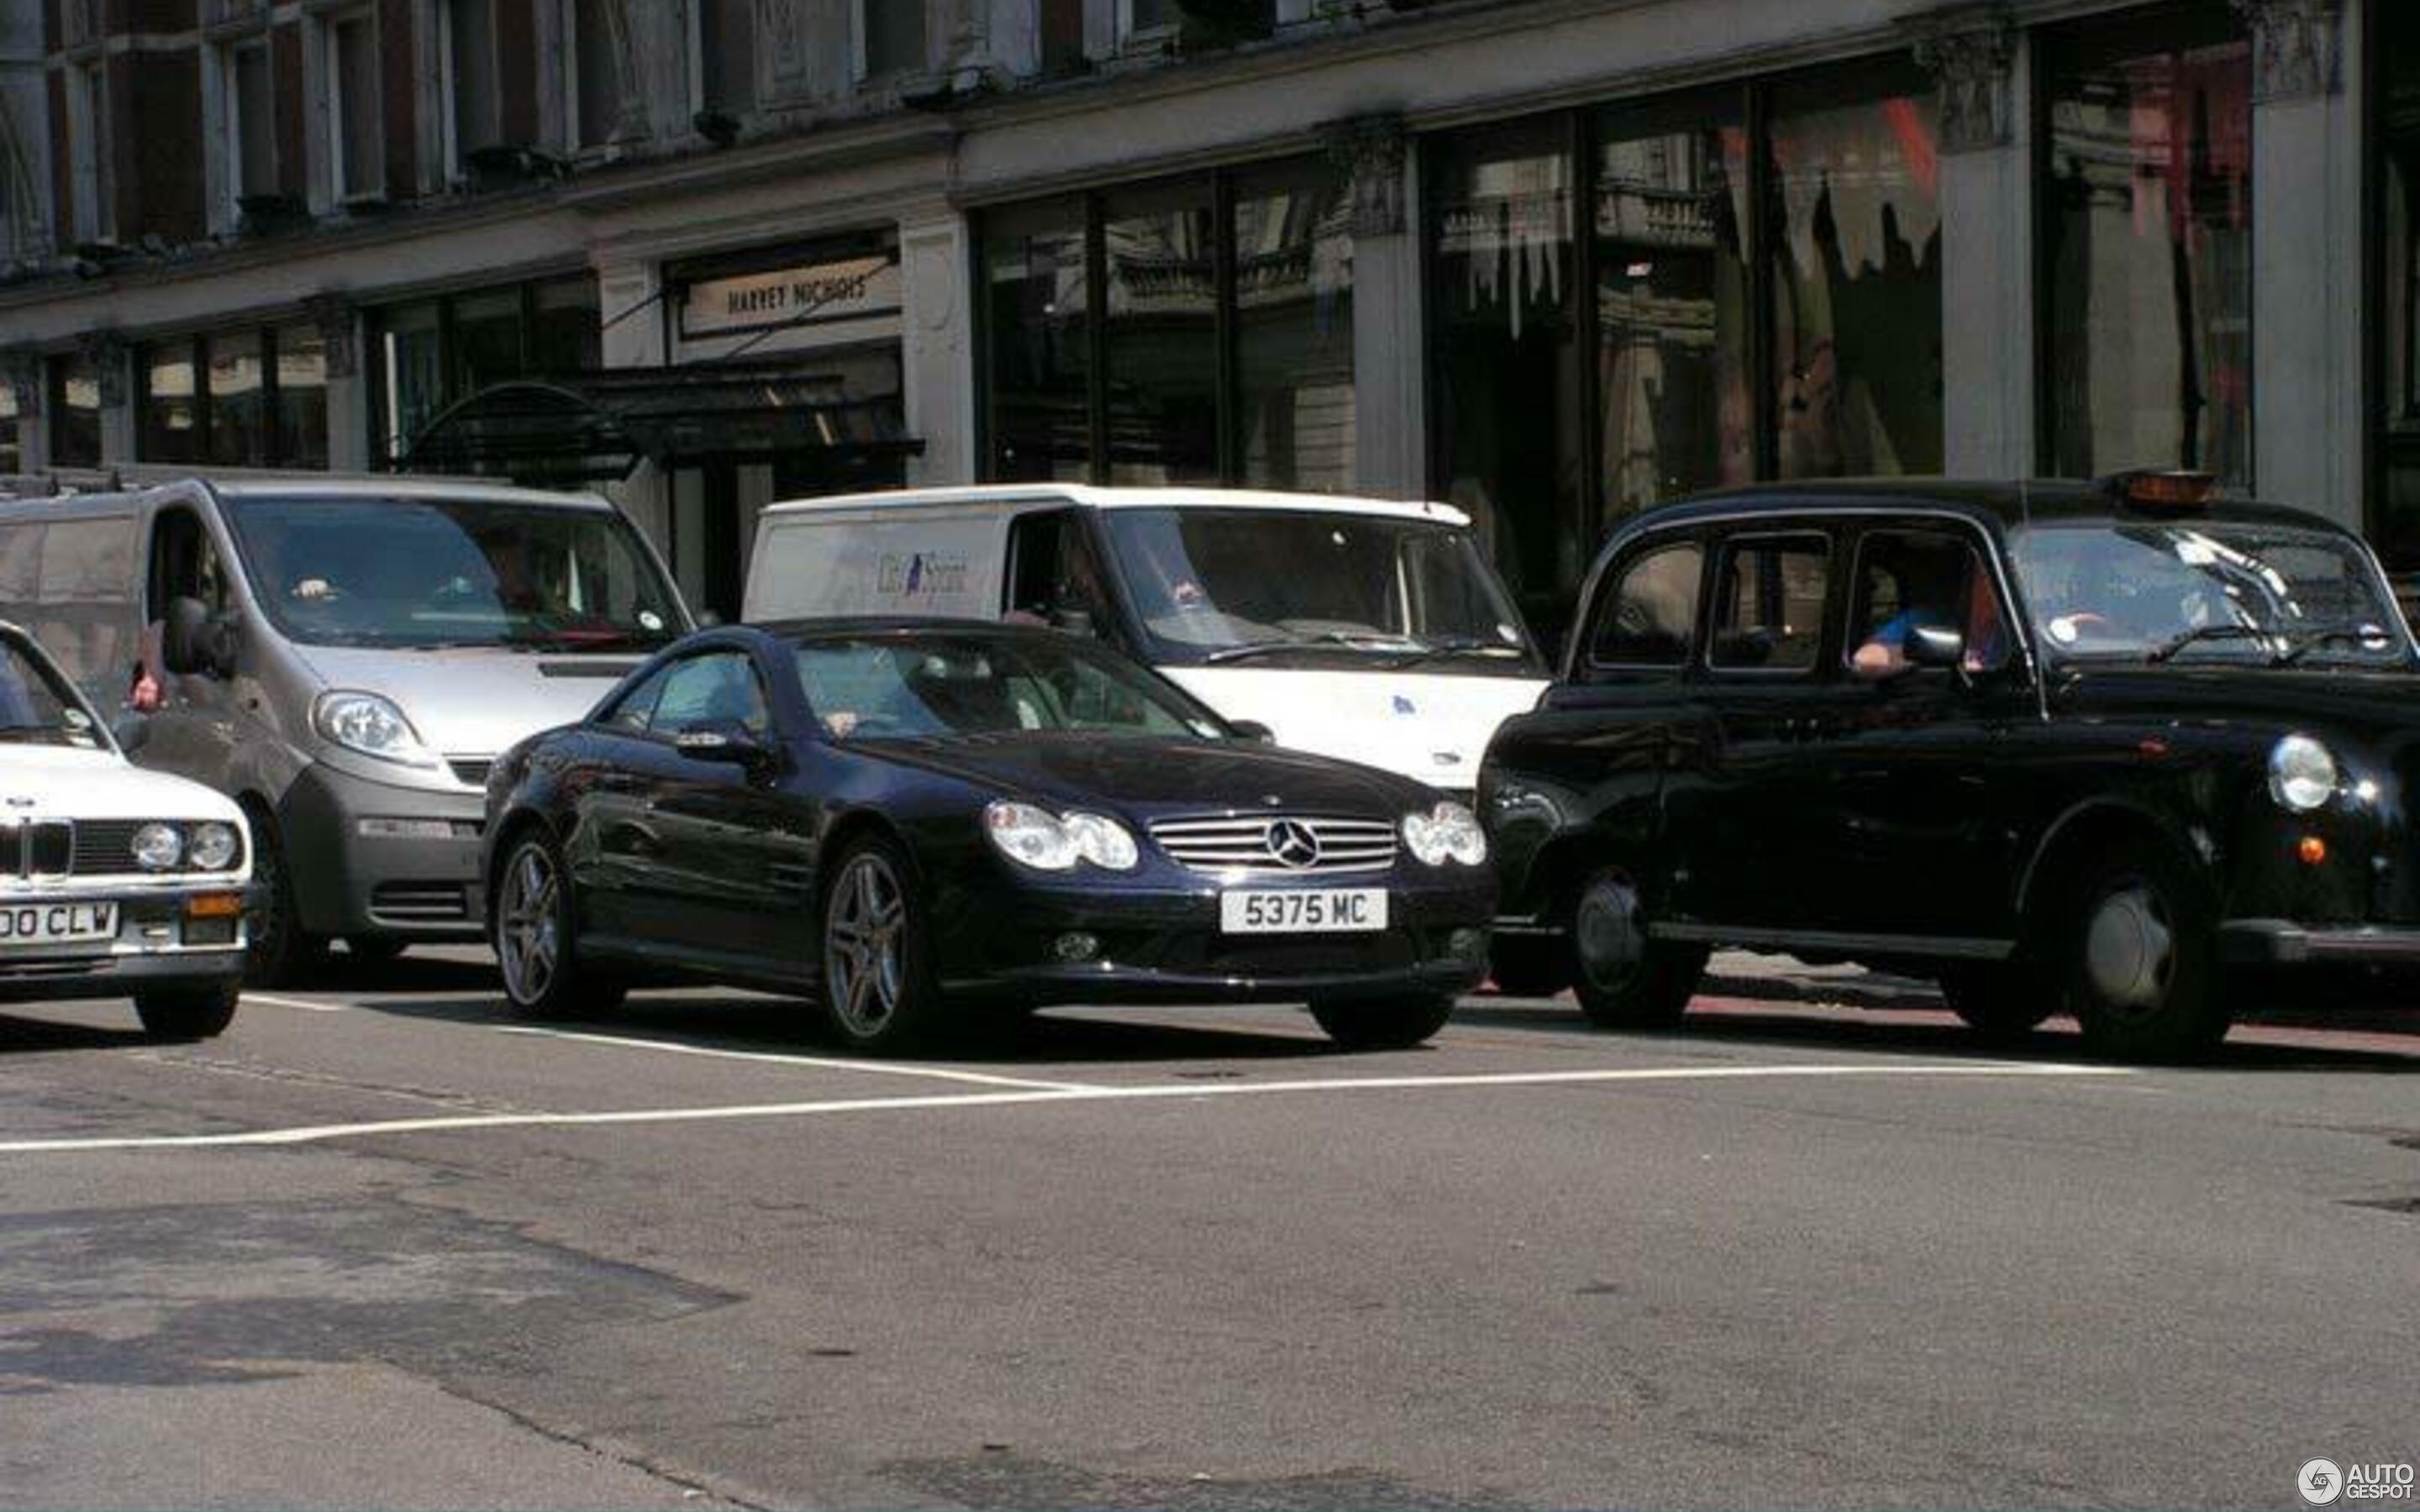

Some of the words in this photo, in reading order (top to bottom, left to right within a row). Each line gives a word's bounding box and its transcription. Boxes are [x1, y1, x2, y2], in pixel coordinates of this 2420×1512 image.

[728, 286, 786, 314] HARVEY
[792, 274, 866, 306] NICHOLS
[48, 904, 113, 935] CLW
[1246, 895, 1323, 925] 5375
[1333, 893, 1366, 924] MC
